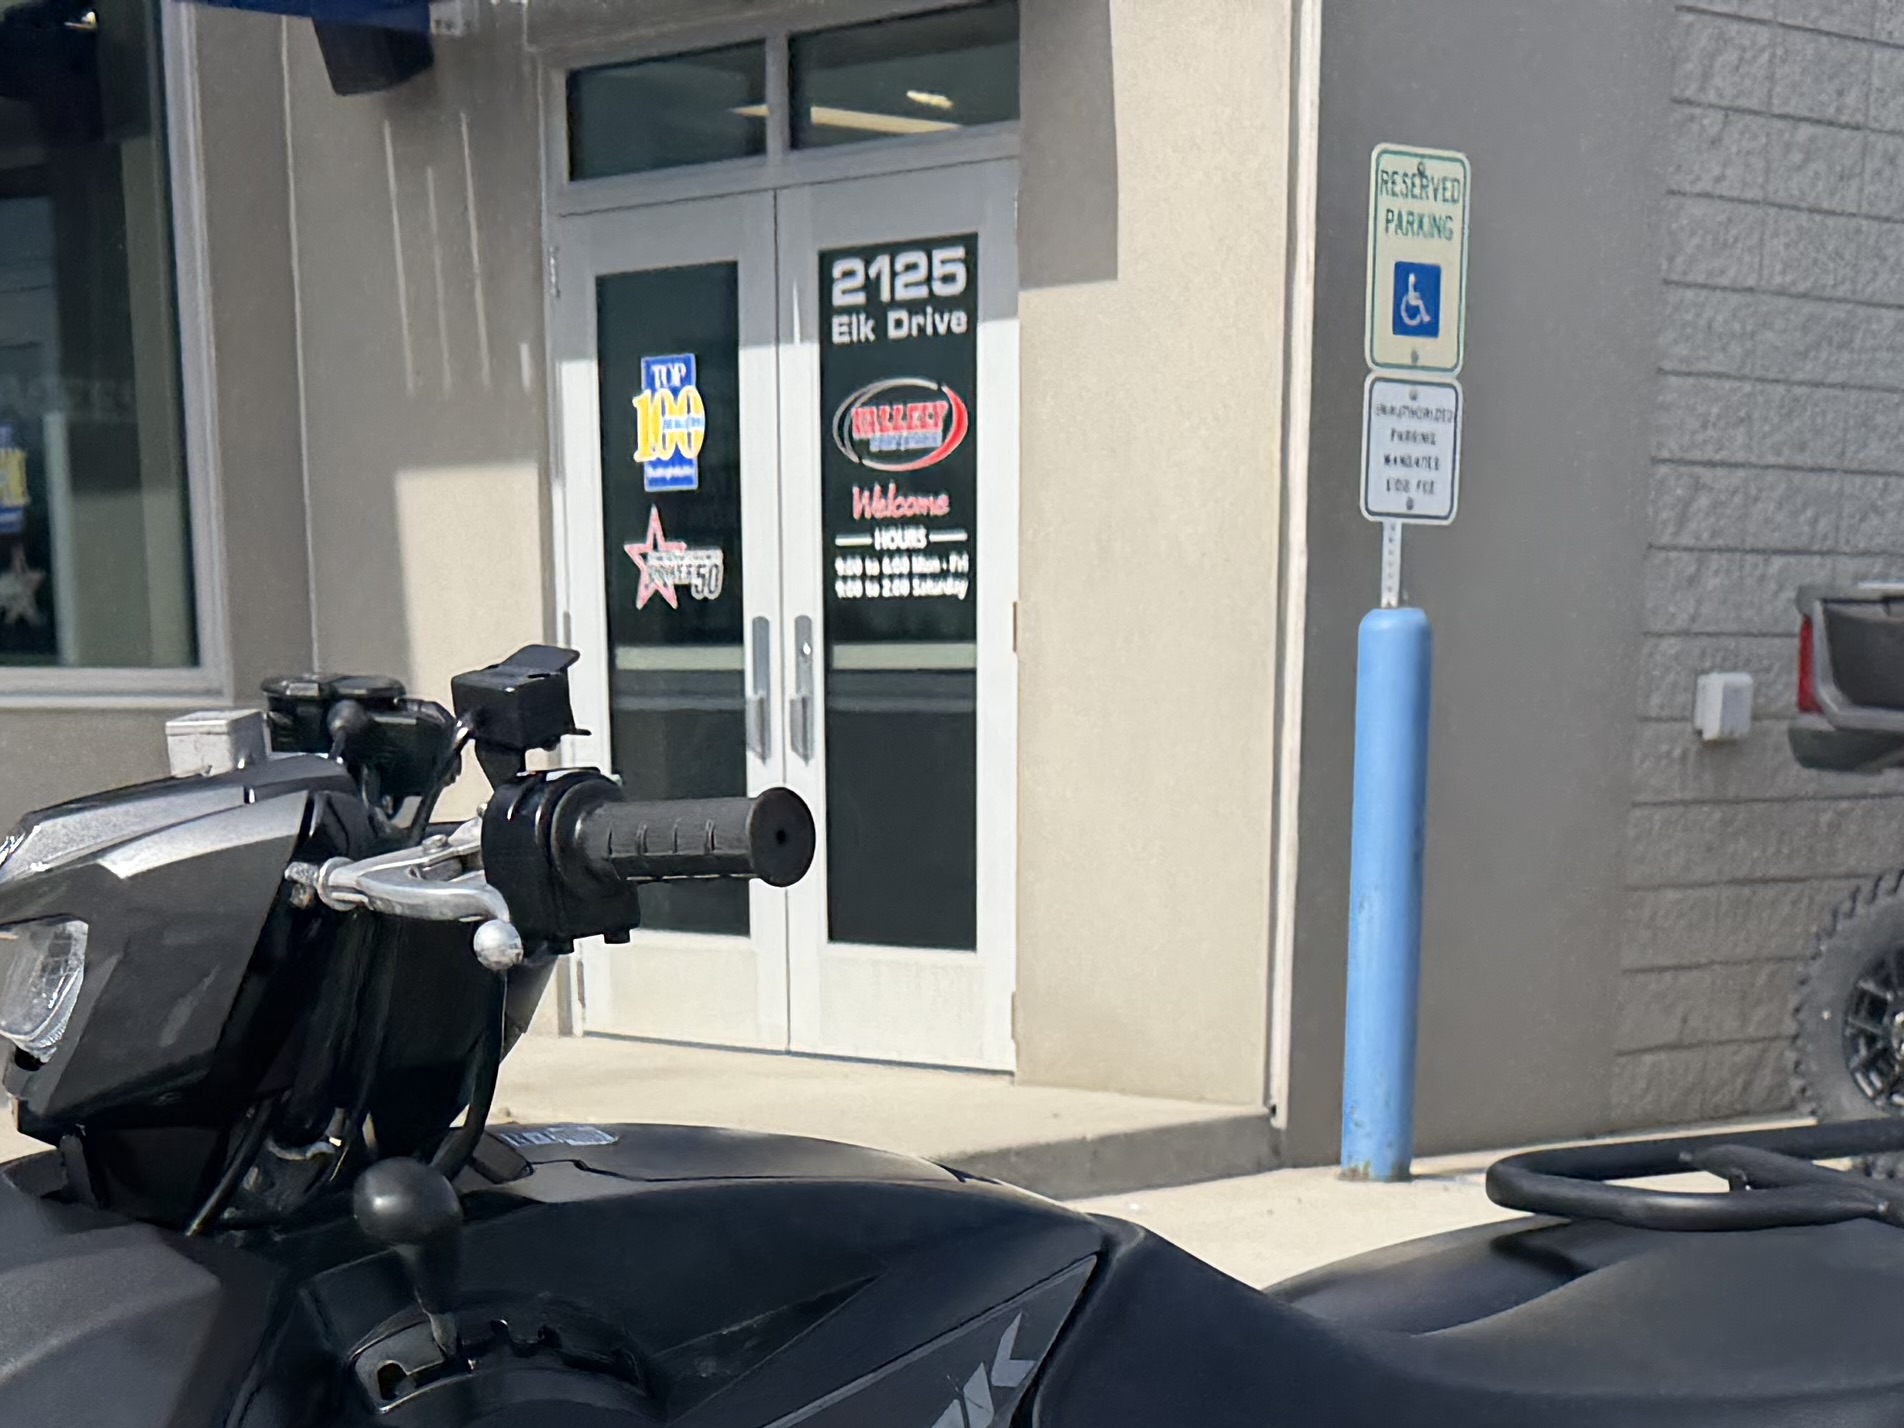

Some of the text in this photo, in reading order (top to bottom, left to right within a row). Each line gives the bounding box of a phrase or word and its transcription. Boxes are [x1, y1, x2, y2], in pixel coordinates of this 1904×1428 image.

[1380, 169, 1461, 204] RESERVED
[1385, 207, 1454, 241] PARKING
[831, 246, 967, 307] 2125
[831, 305, 968, 344] Elk Drive
[652, 362, 687, 388] TOP
[632, 386, 705, 462] 100
[852, 480, 950, 520] Welcome
[874, 524, 927, 550] HOURS
[694, 563, 720, 595] 50
[949, 551, 969, 573] Fri
